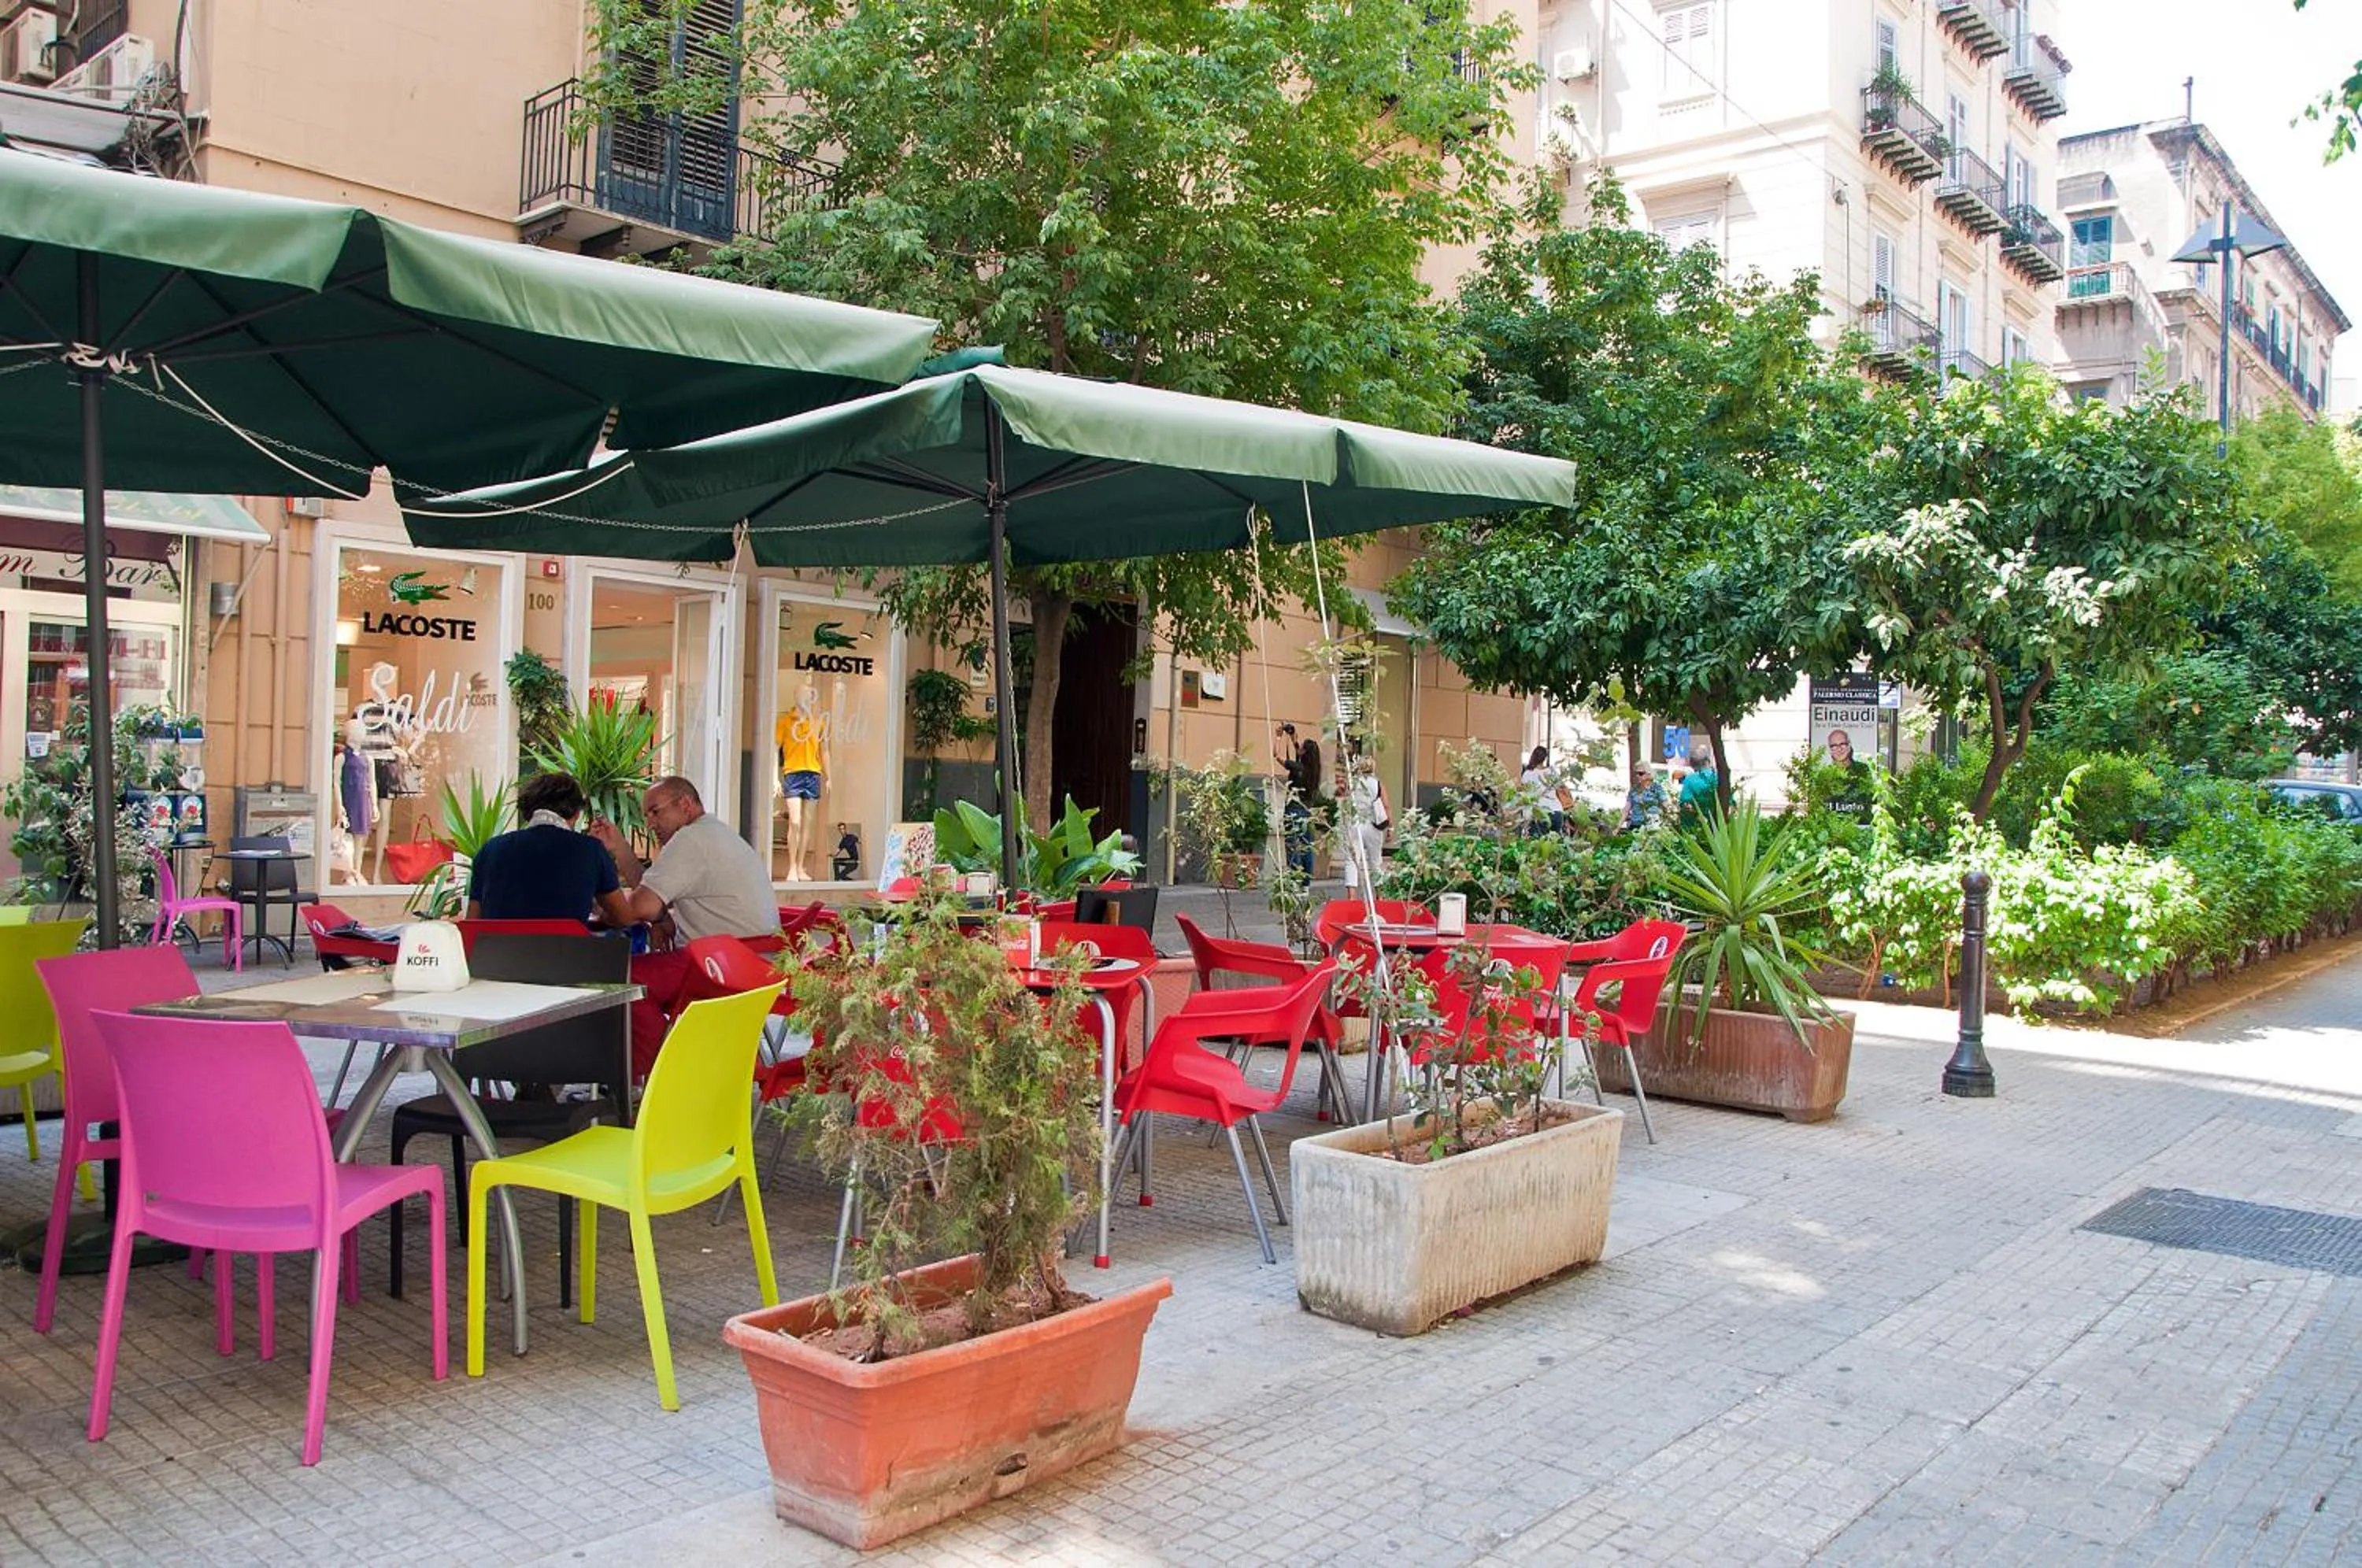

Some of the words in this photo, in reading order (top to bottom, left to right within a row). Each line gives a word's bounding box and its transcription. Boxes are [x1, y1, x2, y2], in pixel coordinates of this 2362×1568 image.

[529, 593, 554, 610] 100
[364, 612, 476, 642] LACOSTE
[794, 652, 874, 675] LACOSTE
[361, 661, 479, 734] Saldi
[1814, 706, 1875, 722] Einaudi
[407, 956, 439, 966] KOFFI
